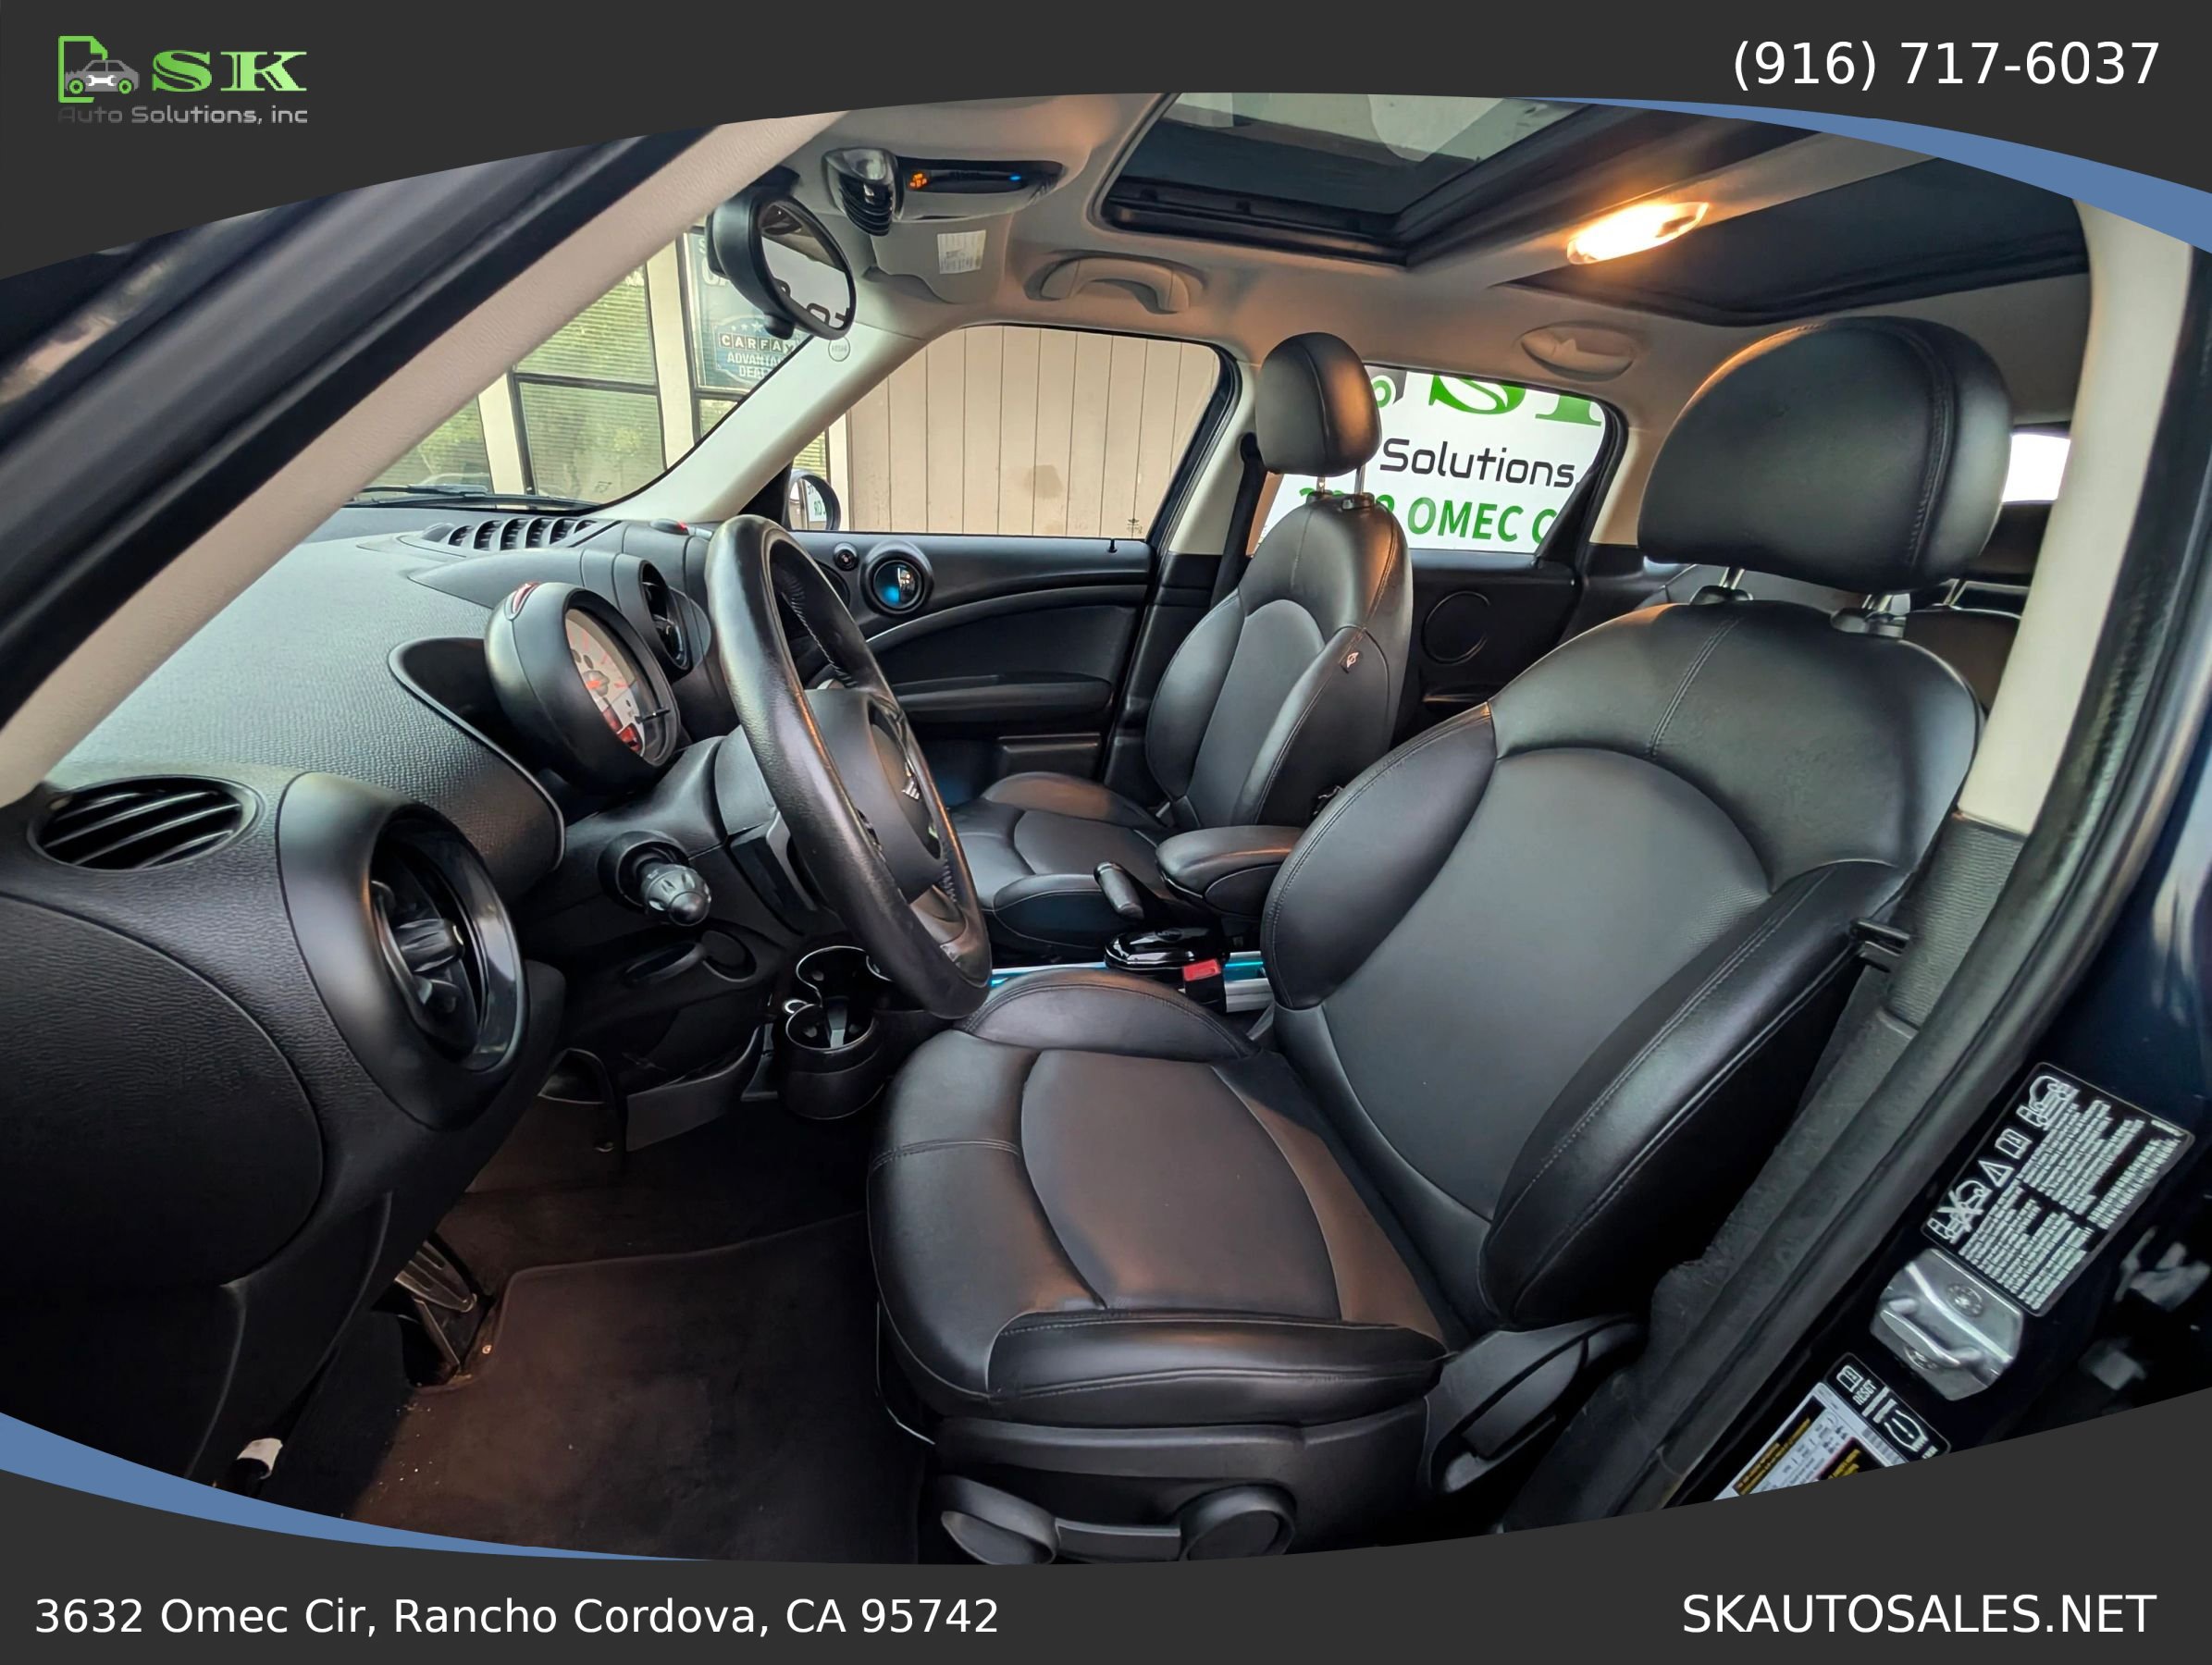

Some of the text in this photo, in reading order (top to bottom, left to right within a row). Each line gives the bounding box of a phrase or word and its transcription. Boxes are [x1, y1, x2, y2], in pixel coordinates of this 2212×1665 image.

[727, 352, 784, 367] ADVANTA
[1379, 438, 1576, 487] Solutions
[1407, 497, 1524, 543] OMEC
[1853, 1379, 1877, 1405] RESET
